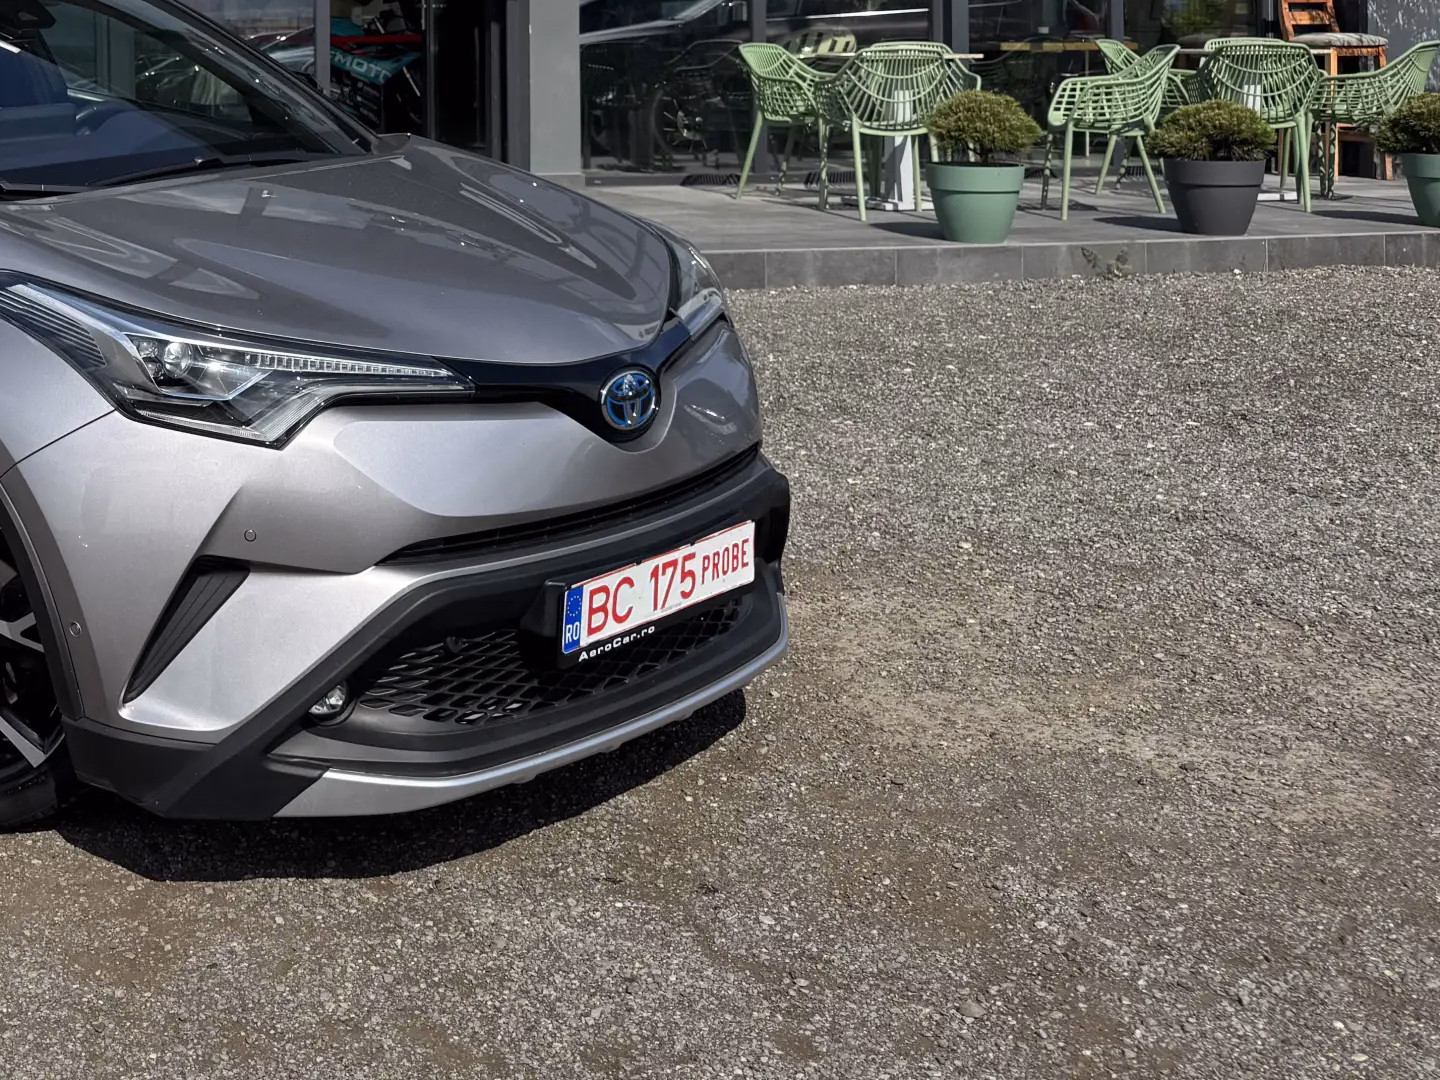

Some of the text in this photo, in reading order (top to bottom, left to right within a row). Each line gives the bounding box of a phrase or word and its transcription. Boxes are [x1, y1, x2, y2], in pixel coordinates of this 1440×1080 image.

[587, 538, 750, 637] BC 175 PROBE
[565, 621, 580, 643] RO
[578, 625, 656, 662] AeroCar.ro
